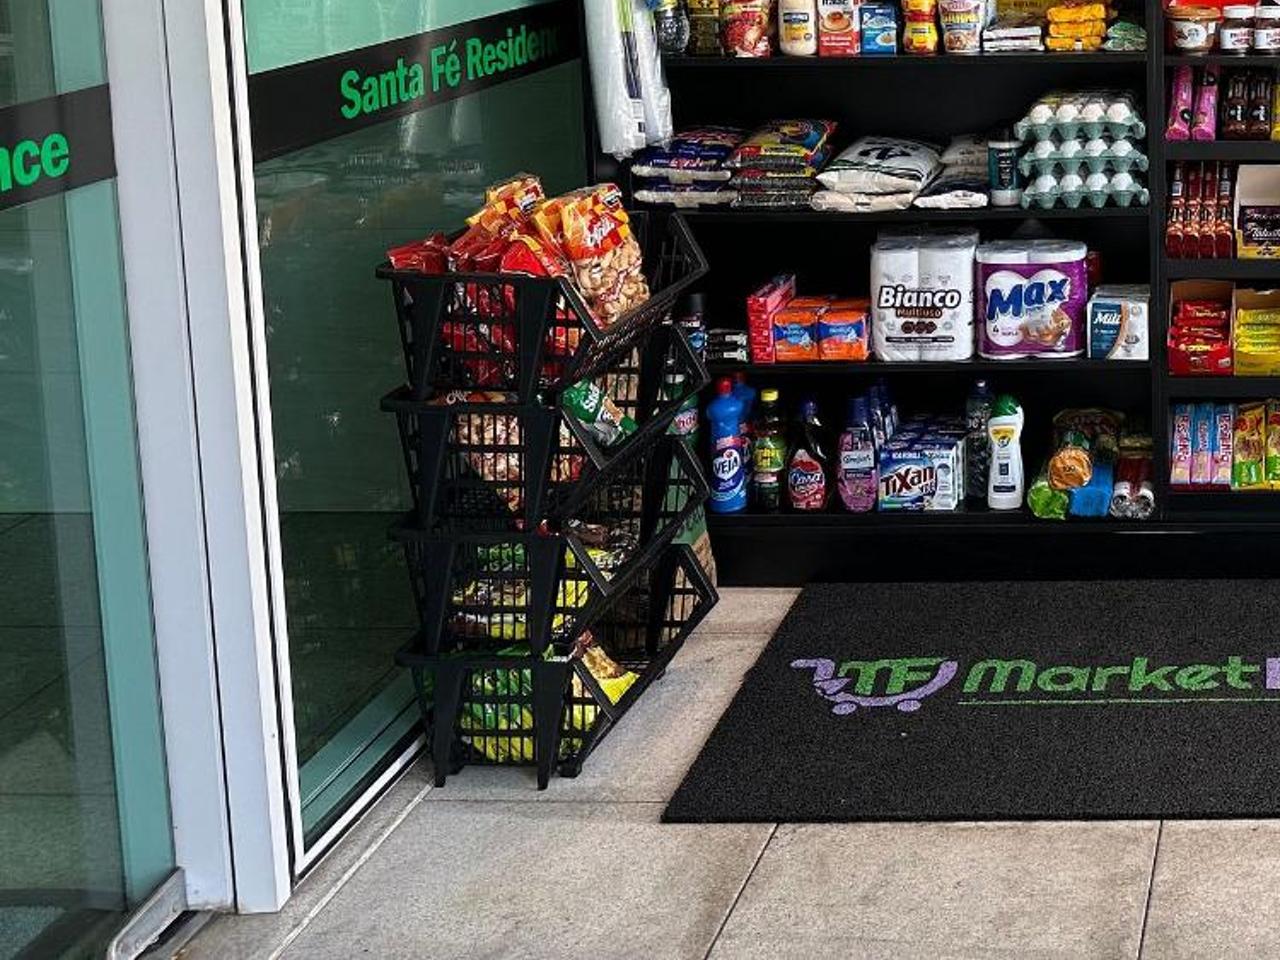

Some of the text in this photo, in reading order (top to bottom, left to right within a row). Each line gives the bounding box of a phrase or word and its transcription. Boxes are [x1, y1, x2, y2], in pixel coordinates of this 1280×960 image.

[339, 58, 424, 119] Santa
[430, 40, 461, 92] Fé
[879, 285, 961, 308] Bianco
[987, 278, 1070, 321] Max
